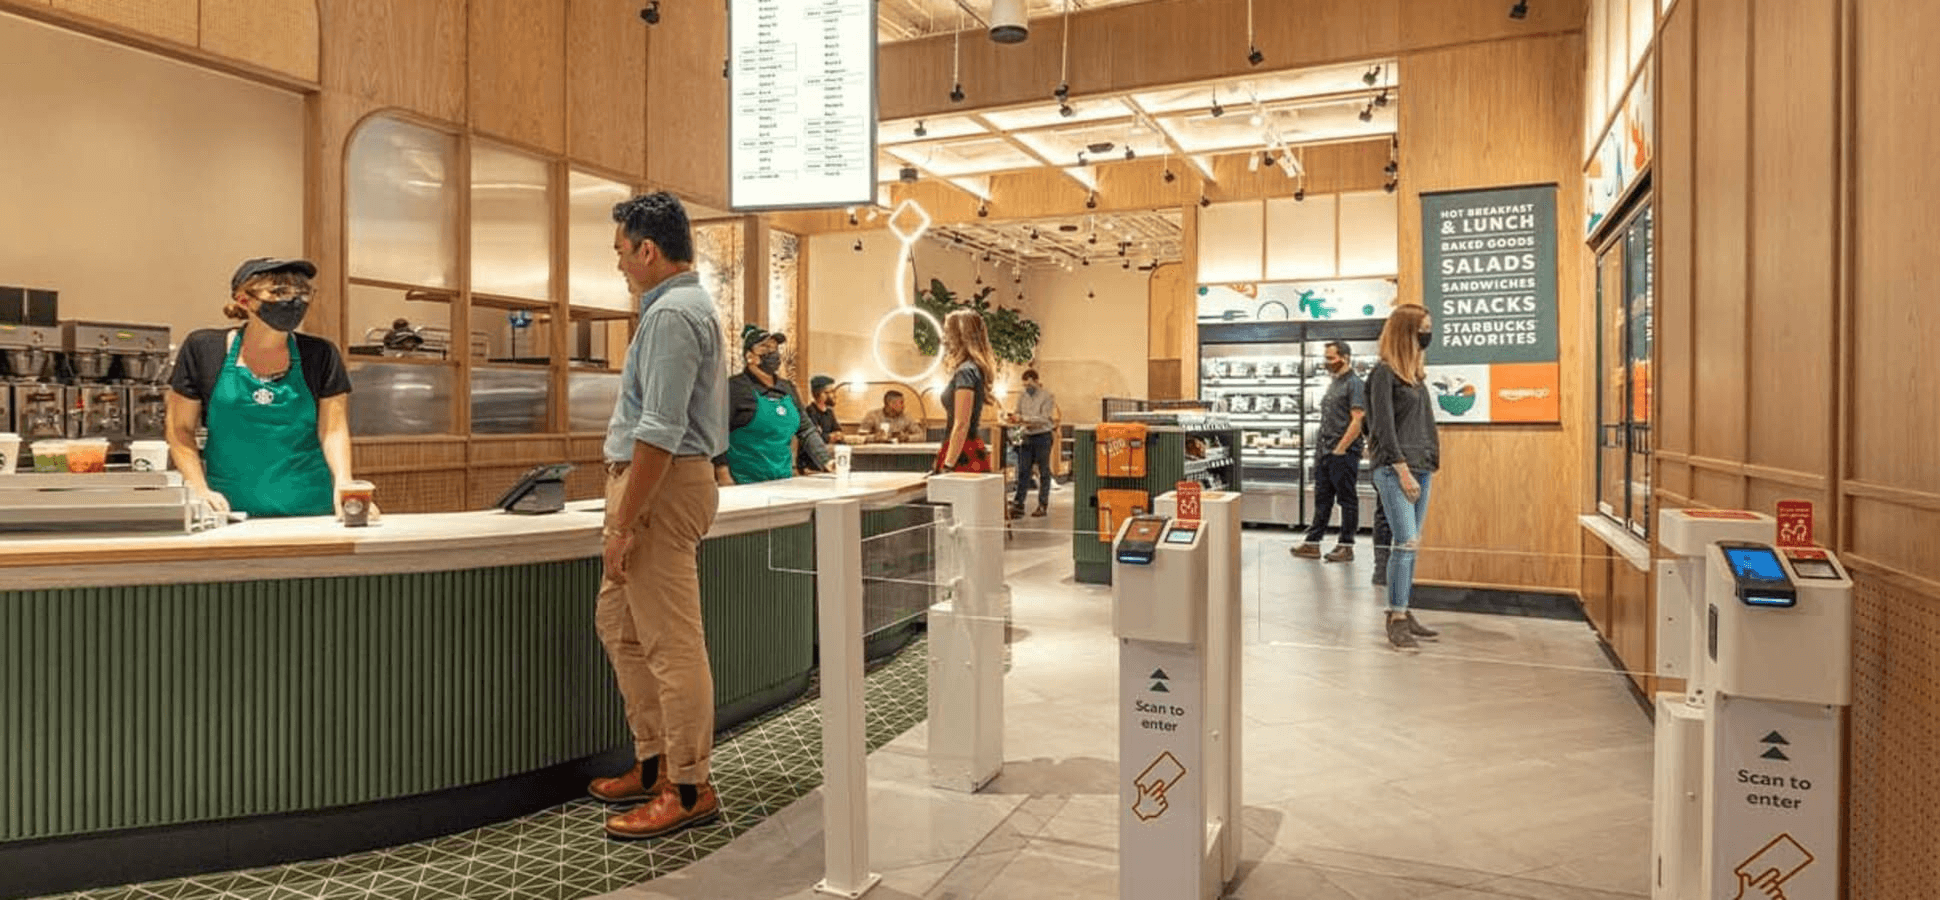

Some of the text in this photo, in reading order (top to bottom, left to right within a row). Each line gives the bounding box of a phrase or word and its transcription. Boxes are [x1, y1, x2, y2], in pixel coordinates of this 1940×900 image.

[1441, 204, 1534, 218] HOT BREAKFAST
[1441, 214, 1535, 234] & LUNCH
[1441, 236, 1535, 251] BAKED GOODS
[1441, 254, 1535, 274] SALADS
[1441, 278, 1536, 292] SANDWICHES
[1442, 295, 1536, 314] SNACKS
[1442, 320, 1536, 334] STARBUCKS
[1442, 332, 1537, 347] FAVORITES
[1135, 700, 1185, 716] Scan to
[1141, 719, 1178, 731] enter
[1737, 769, 1812, 790] Scan to
[1746, 793, 1802, 810] enter
